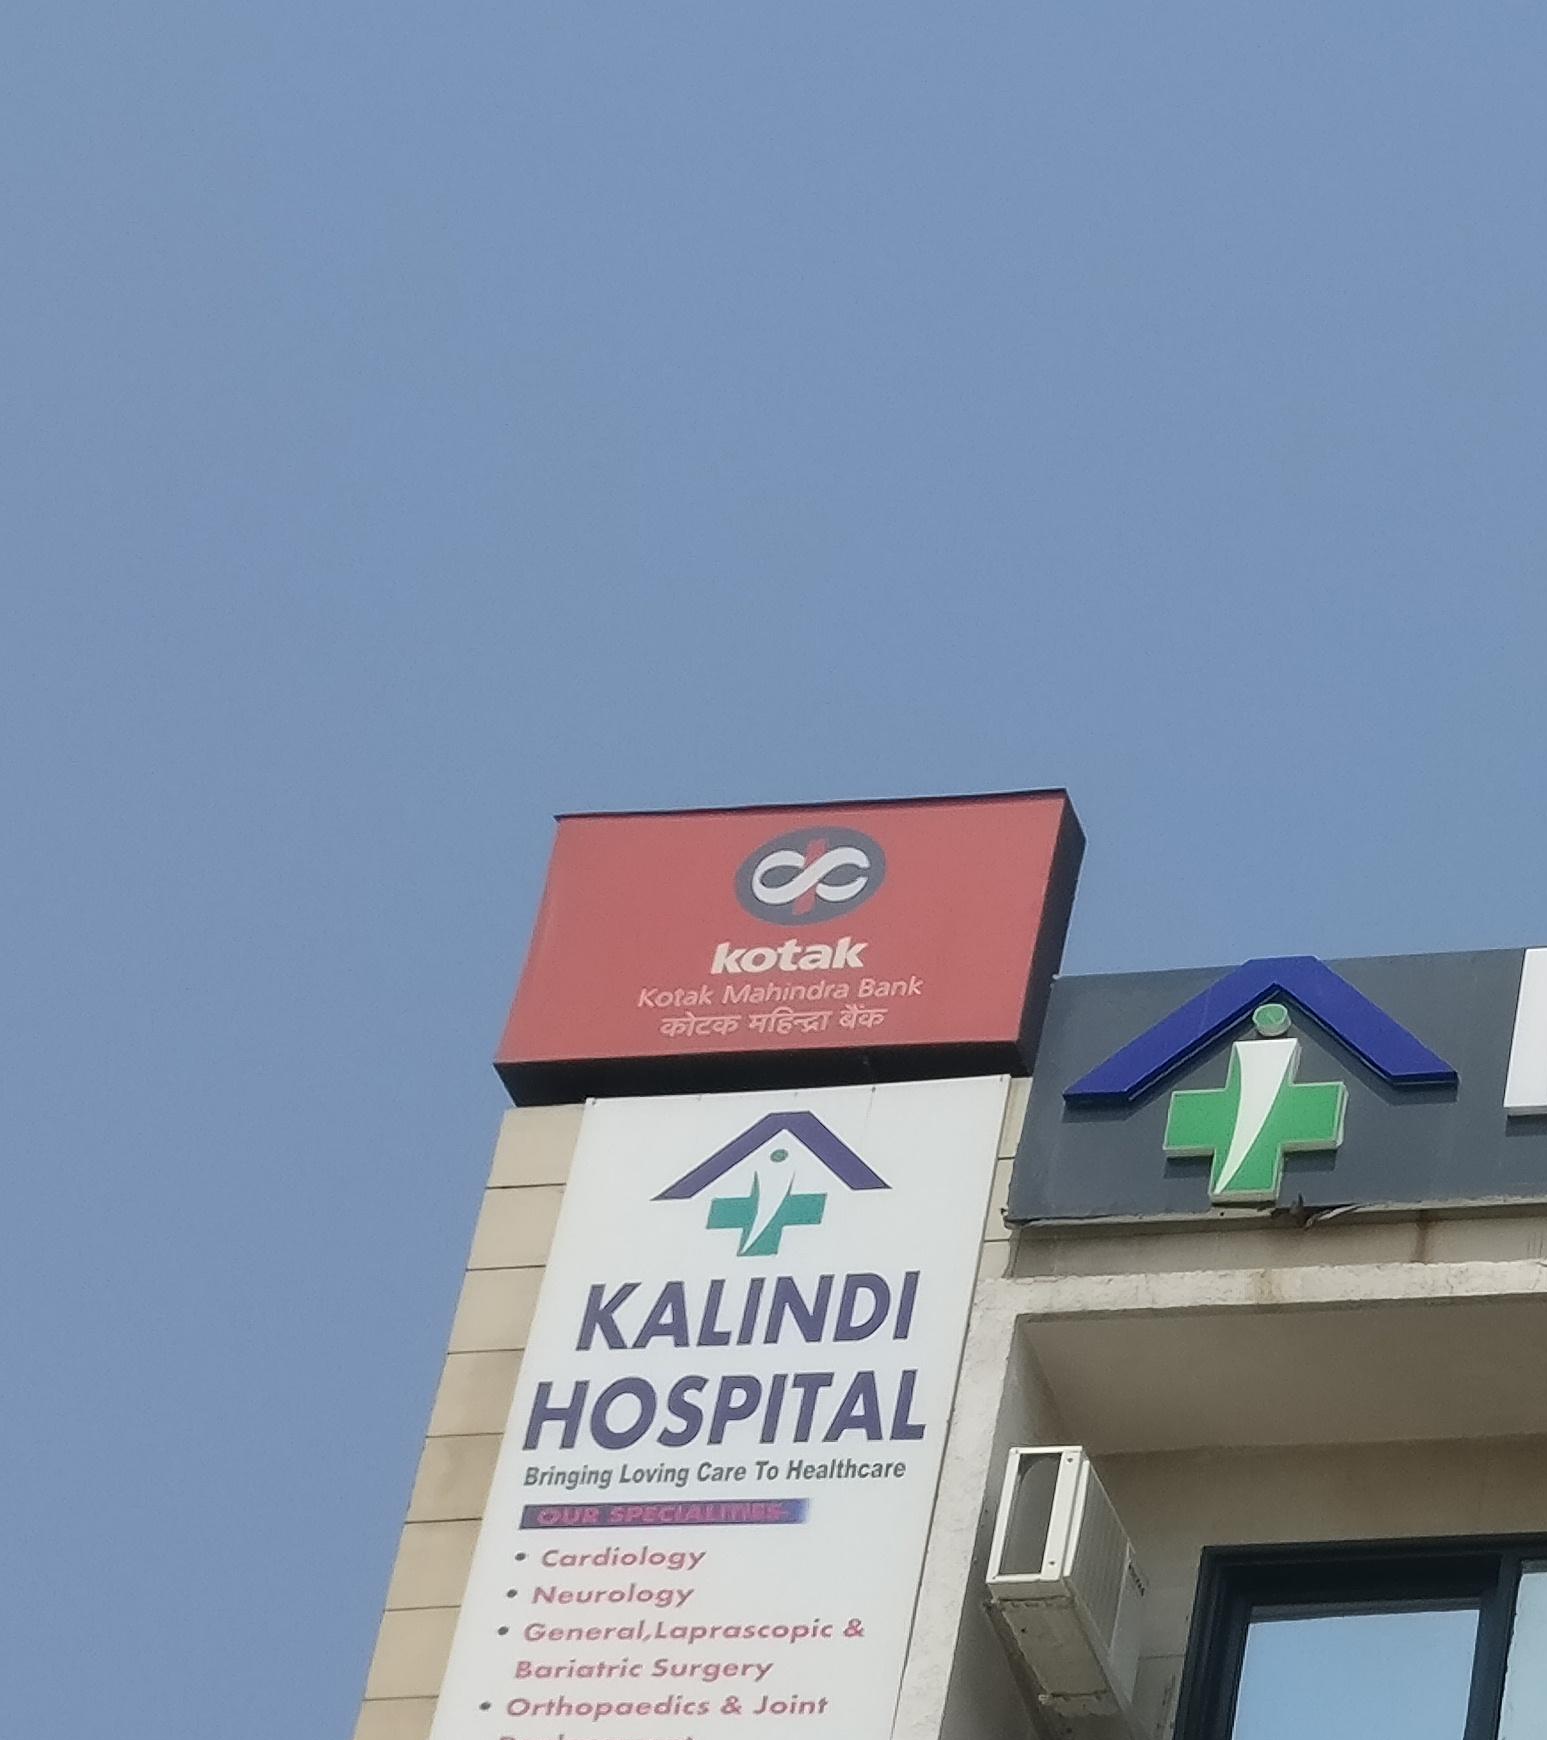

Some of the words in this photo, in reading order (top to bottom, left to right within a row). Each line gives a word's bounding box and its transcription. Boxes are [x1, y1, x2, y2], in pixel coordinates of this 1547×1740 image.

[710, 936, 869, 975] kotak
[637, 983, 712, 1010] Kotak
[722, 977, 850, 1004] Mahindra
[858, 973, 924, 998] Bank
[659, 1011, 738, 1038] कोटक
[838, 1002, 888, 1029] बैंक
[575, 1270, 921, 1352] KALINDI
[523, 1368, 927, 1450] HOSPITAL
[523, 1464, 612, 1489] Bringing
[618, 1461, 690, 1488] Loving
[696, 1461, 748, 1483] Care
[754, 1460, 780, 1481] To
[786, 1457, 906, 1481] Healthcare
[535, 1504, 599, 1527] OUR
[540, 1544, 707, 1571] Cardiology
[530, 1583, 695, 1608] Neurology
[842, 1617, 866, 1639] &
[513, 1656, 644, 1680] Bariatric
[650, 1655, 775, 1683] Surgery
[505, 1695, 710, 1722] Orthopaedics
[720, 1695, 743, 1717] &
[752, 1694, 829, 1717] Joint
